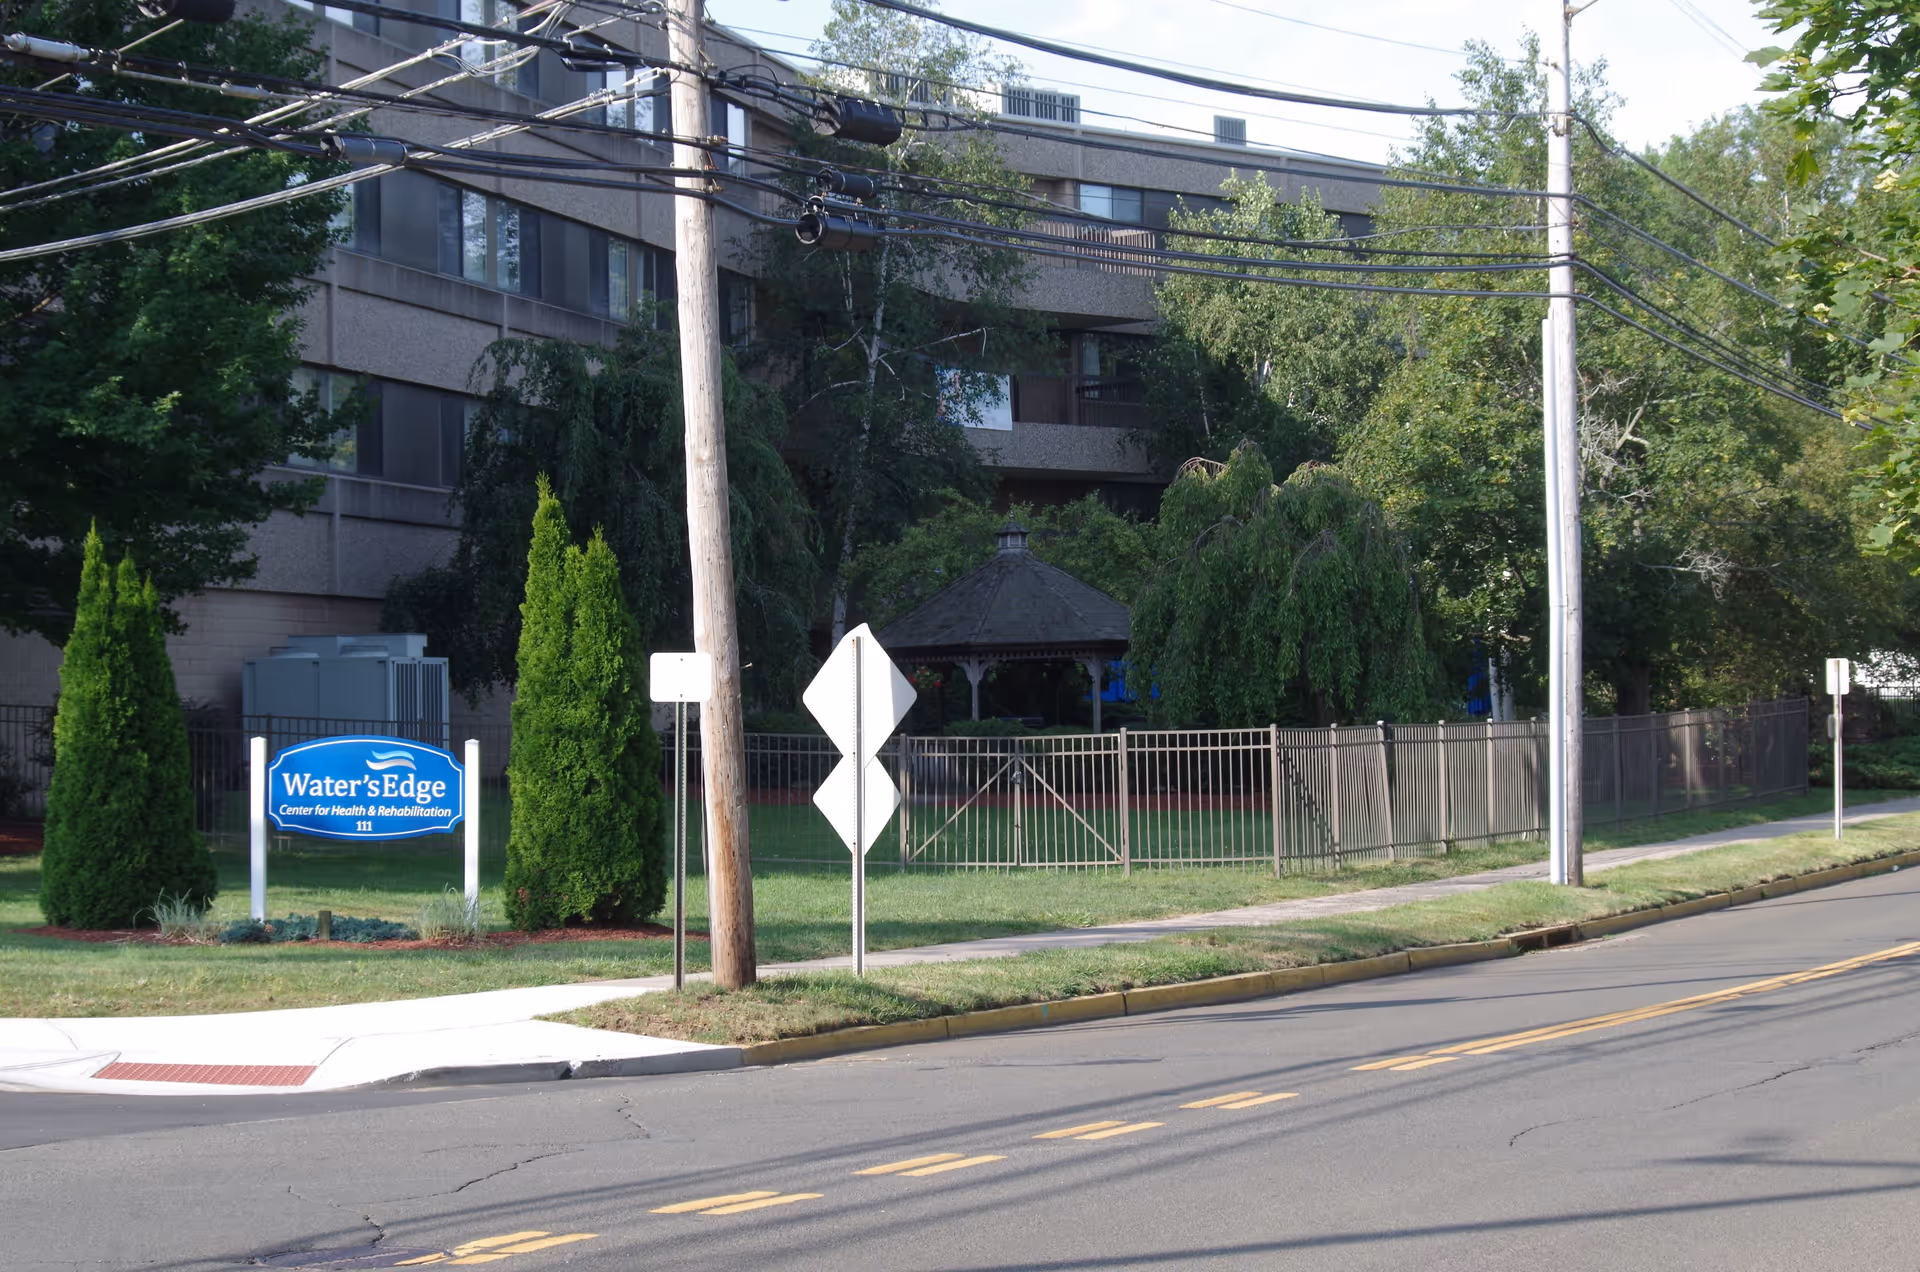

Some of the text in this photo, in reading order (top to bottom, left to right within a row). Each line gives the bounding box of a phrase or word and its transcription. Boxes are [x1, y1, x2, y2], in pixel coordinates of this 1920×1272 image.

[279, 804, 452, 818] Center for Health & Rehabilitation
[355, 820, 373, 832] 111
